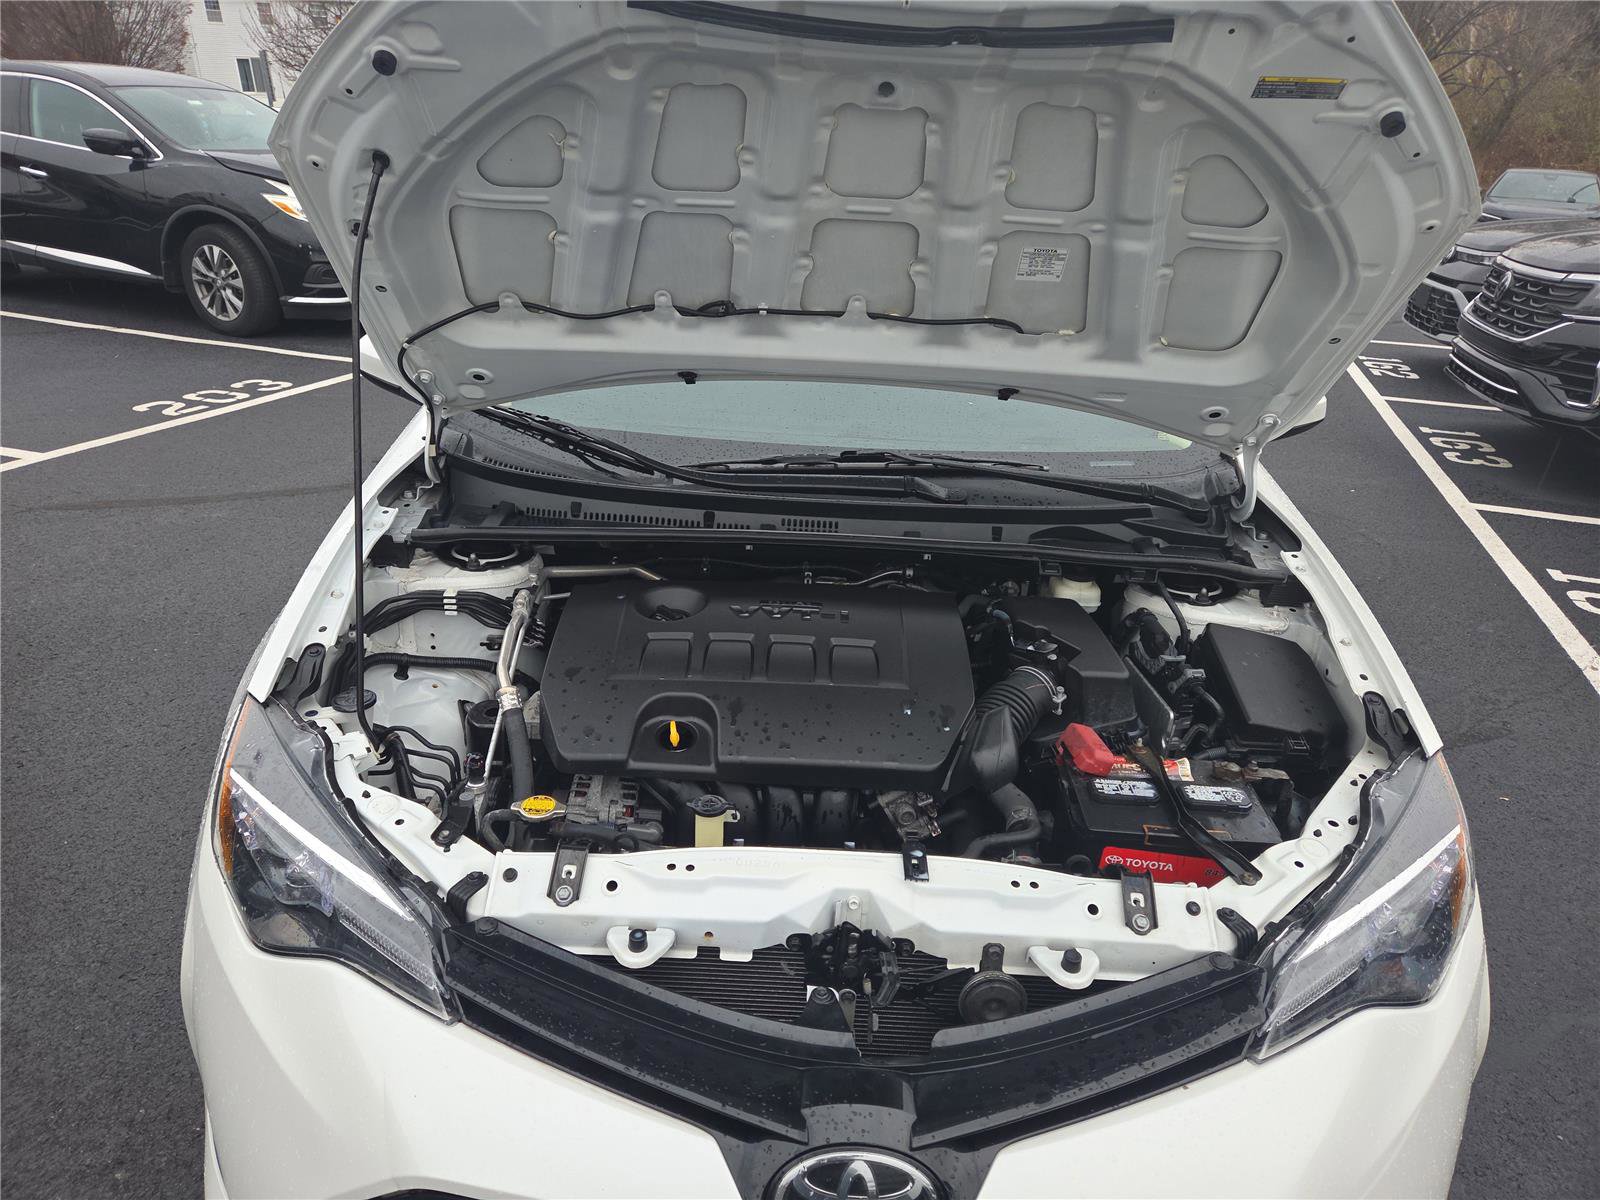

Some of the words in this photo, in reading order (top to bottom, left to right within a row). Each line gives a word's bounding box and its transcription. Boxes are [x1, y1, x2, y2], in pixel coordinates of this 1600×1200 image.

[1359, 355, 1420, 380] 162
[132, 379, 293, 416] 203
[1418, 426, 1514, 469] 163
[1125, 857, 1174, 872] TOYOTA
